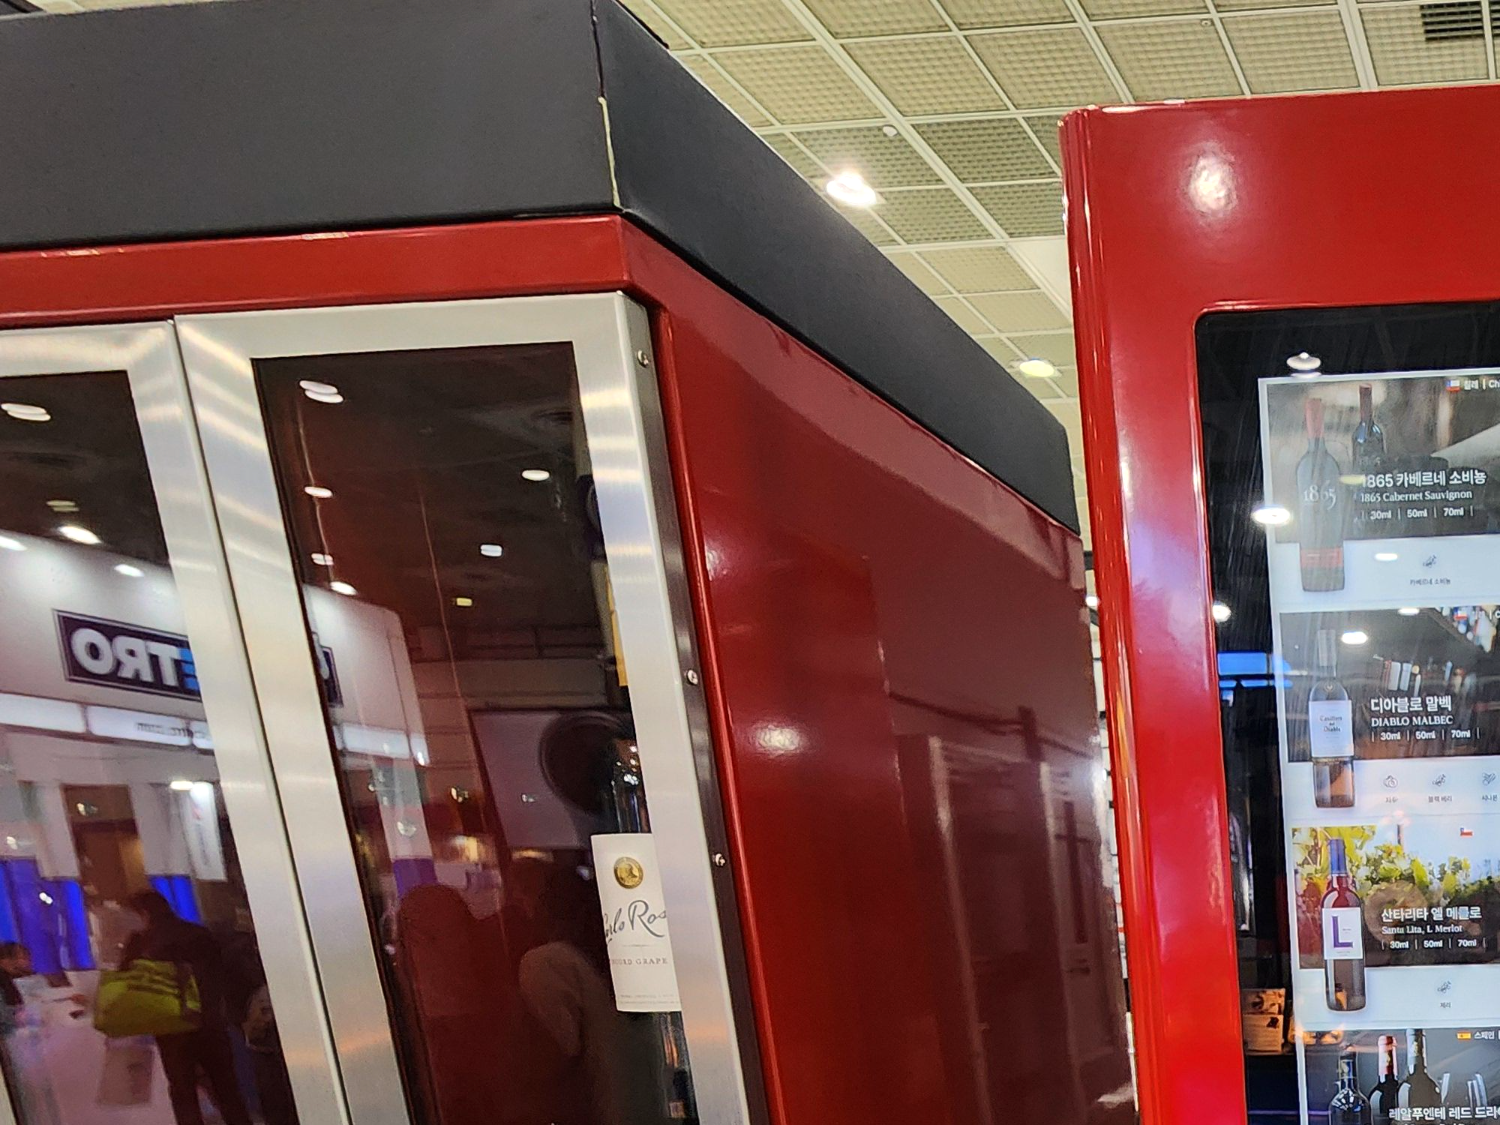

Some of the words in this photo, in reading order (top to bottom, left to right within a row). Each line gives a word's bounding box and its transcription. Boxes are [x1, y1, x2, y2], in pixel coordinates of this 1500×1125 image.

[1396, 471, 1446, 487] 카베르네
[1449, 470, 1487, 485] 소비뇽
[1303, 479, 1336, 510] 1865
[1361, 493, 1381, 503] 1865
[1383, 491, 1424, 502] Cabernet
[1424, 489, 1472, 502] Sauvignon
[1370, 510, 1392, 520] 30ml
[1443, 507, 1464, 517] 70ml
[1371, 696, 1423, 714] 디아블로
[1426, 695, 1452, 713] 말백
[1371, 716, 1410, 727] DIABLO
[1412, 715, 1454, 726] MALBEC
[1380, 731, 1401, 741] 30ml
[1451, 729, 1471, 739] 70ml
[628, 900, 667, 938] Ros
[1381, 907, 1429, 923] 산타리타
[1431, 906, 1444, 921] 엘
[1332, 915, 1354, 949] L
[1434, 924, 1463, 933] Merlot
[1390, 940, 1409, 949] 30ml
[1457, 939, 1477, 948] 70ml
[635, 957, 668, 965] GRAPE
[1388, 1106, 1446, 1121] 레알푸엔테
[1448, 1106, 1473, 1120] 레드
